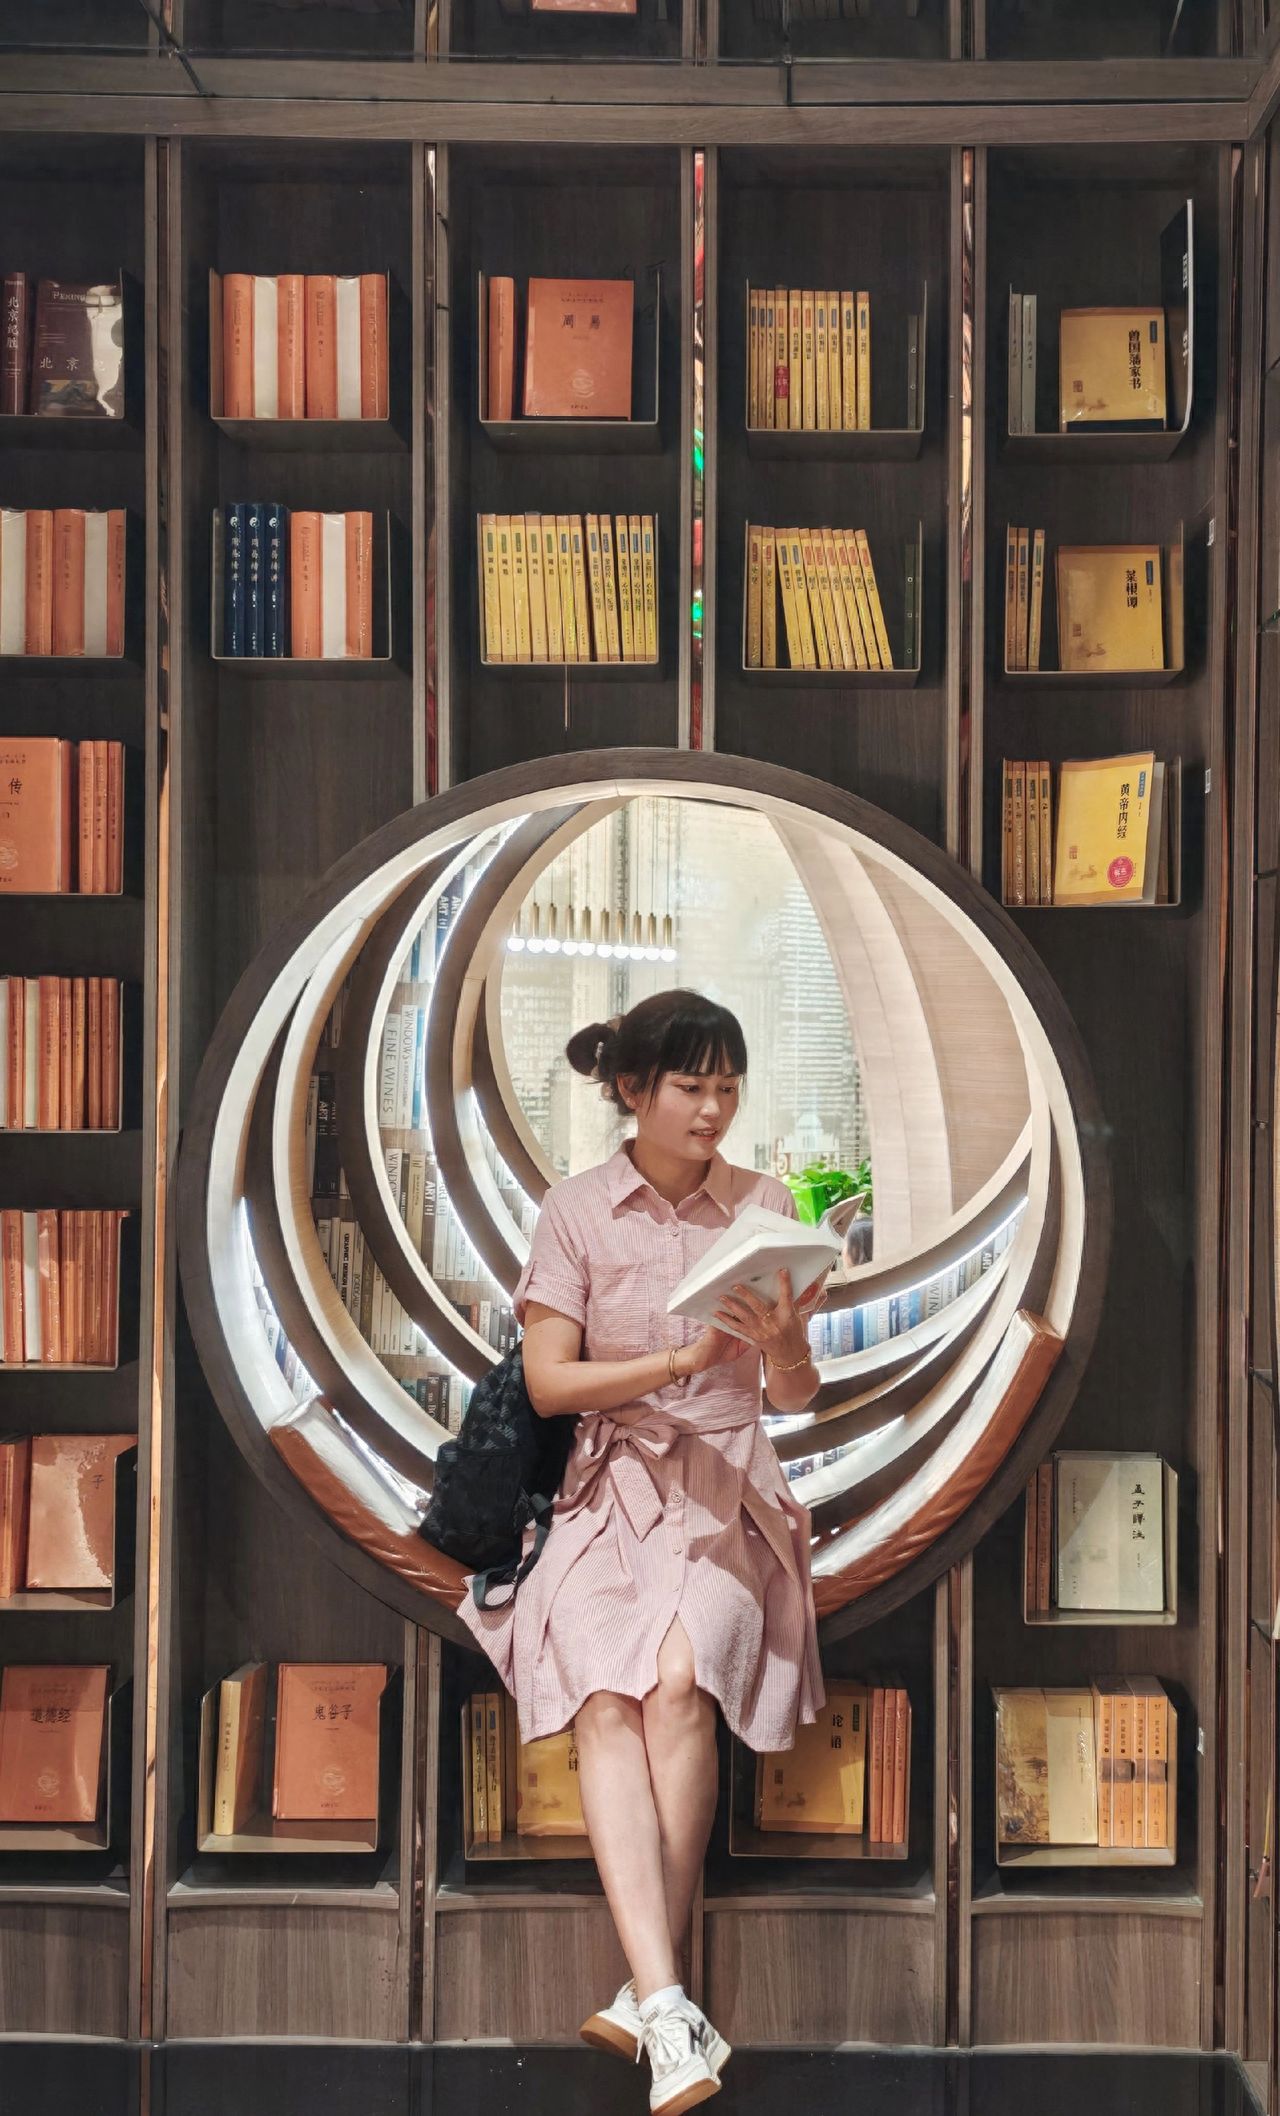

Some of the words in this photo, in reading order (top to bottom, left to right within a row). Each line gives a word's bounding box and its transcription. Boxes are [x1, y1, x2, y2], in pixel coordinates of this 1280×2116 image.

[8, 777, 23, 795] 传
[1117, 783, 1130, 839] 黄帝内经
[386, 1029, 399, 1061] FINE
[402, 1009, 416, 1060] WINDOWS
[382, 1066, 396, 1113] WINES
[424, 1180, 436, 1201] ART
[30, 1706, 72, 1724] 道德经
[312, 1703, 354, 1721] 鬼谷子
[831, 1714, 844, 1750] 论语
